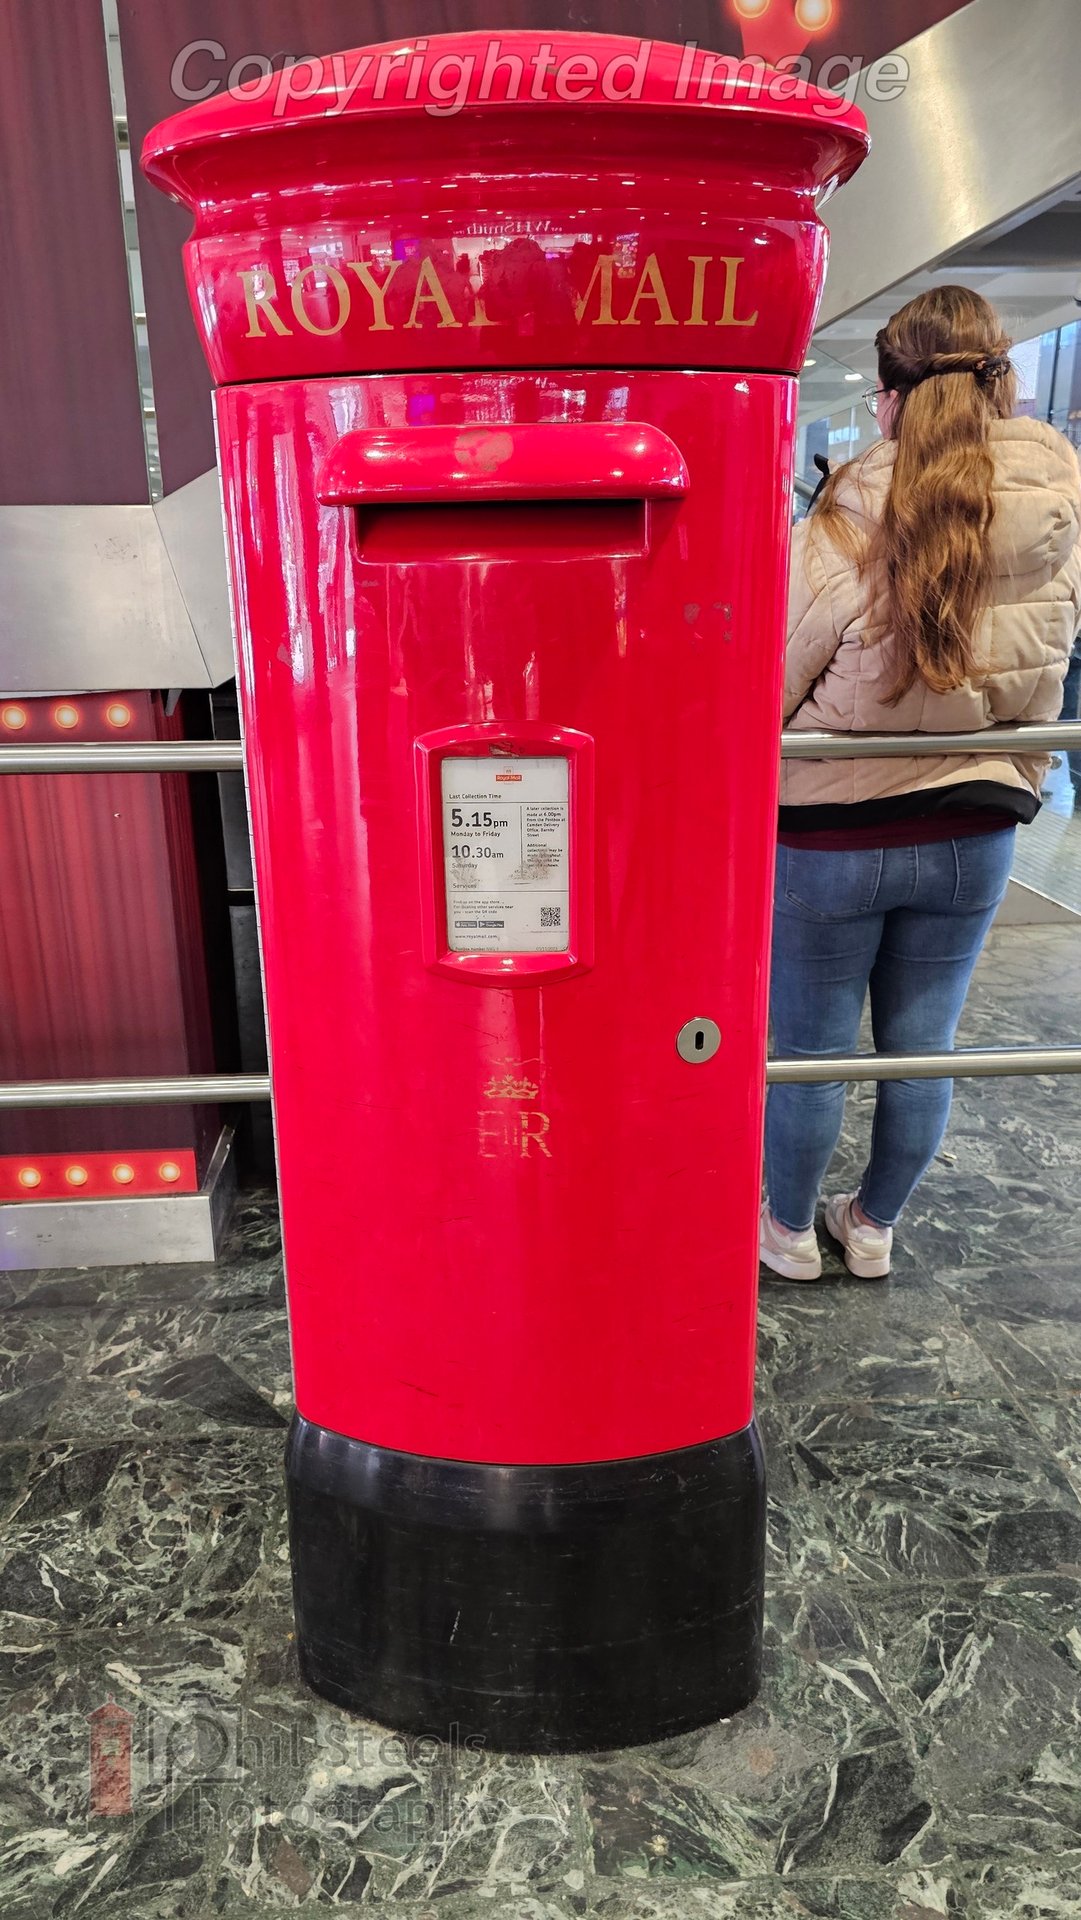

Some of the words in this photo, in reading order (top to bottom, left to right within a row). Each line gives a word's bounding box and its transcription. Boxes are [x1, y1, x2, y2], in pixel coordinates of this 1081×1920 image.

[573, 252, 759, 327] MAIL
[451, 808, 508, 829] 5.15pm
[451, 844, 504, 859] 10.30am
